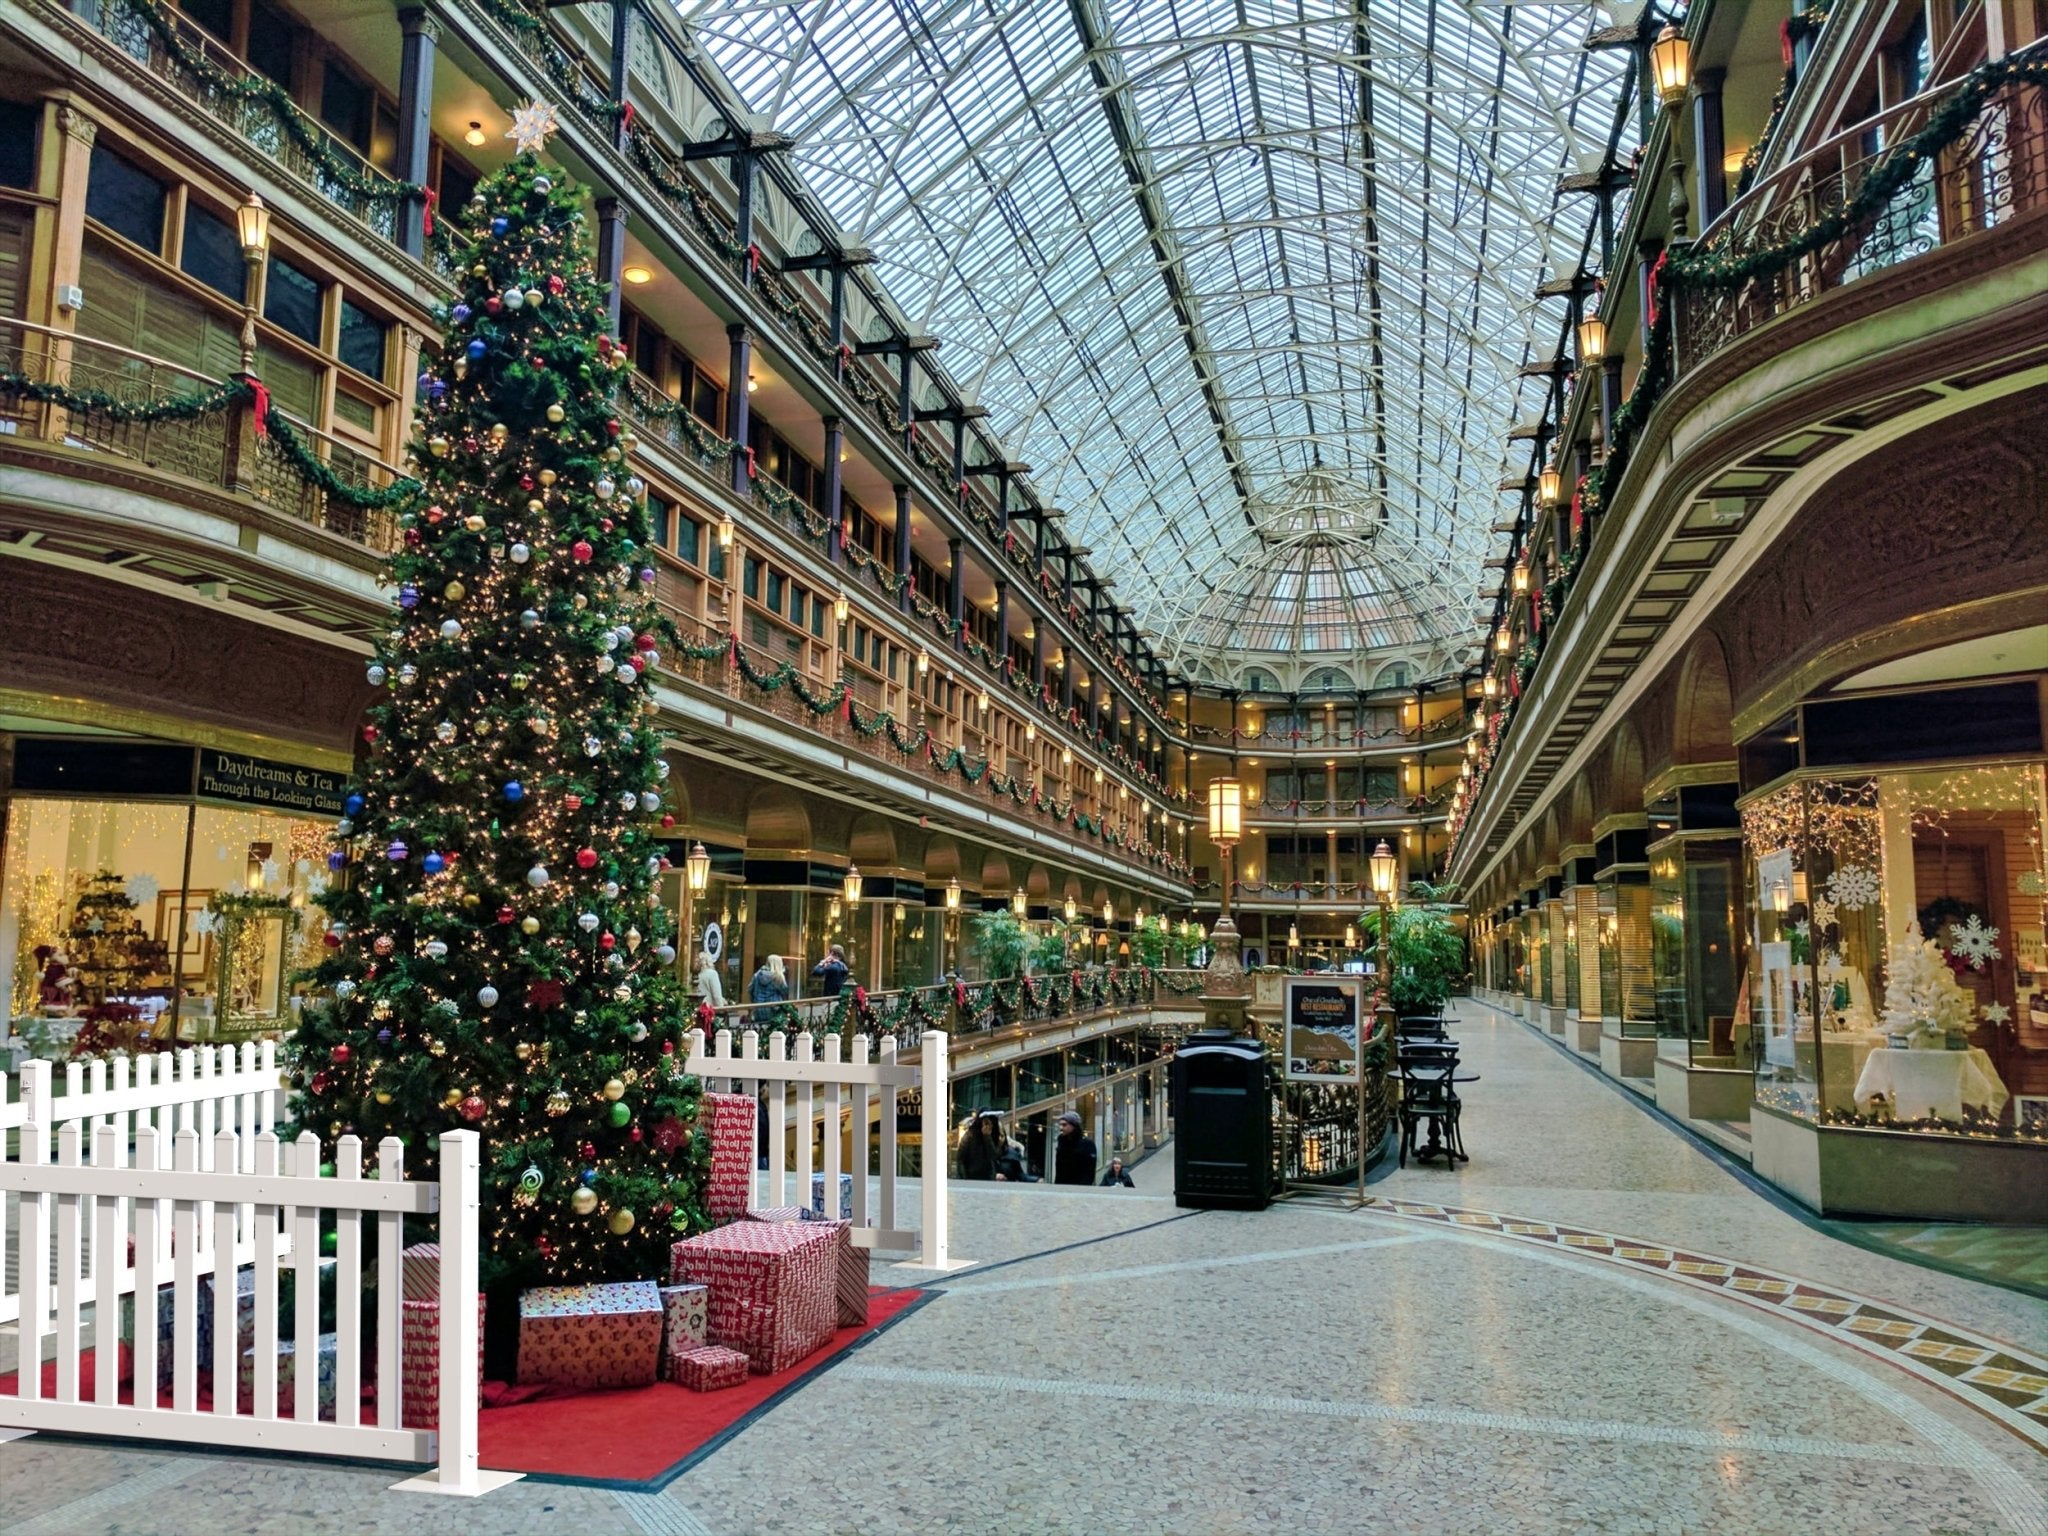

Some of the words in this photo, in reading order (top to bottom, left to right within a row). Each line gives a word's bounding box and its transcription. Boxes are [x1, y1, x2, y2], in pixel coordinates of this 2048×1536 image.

[217, 755, 292, 783] Daydreams
[294, 770, 309, 786] &
[312, 773, 333, 791] Tea
[203, 776, 250, 797] Through
[253, 785, 270, 799] the
[272, 787, 312, 808] Looking
[314, 795, 342, 810] Glass
[897, 1093, 922, 1104] OO
[682, 1247, 690, 1257] ho
[692, 1247, 705, 1257] ho!
[708, 1249, 718, 1258] ho
[720, 1250, 729, 1260] ho
[731, 1251, 744, 1260] ho!
[746, 1252, 757, 1262] ho
[759, 1253, 769, 1264] ho
[684, 1259, 694, 1270] ho
[695, 1260, 708, 1270] ho!
[710, 1261, 721, 1271] ho
[722, 1263, 732, 1274] ho
[734, 1263, 747, 1274] ho!
[749, 1265, 760, 1275] ho
